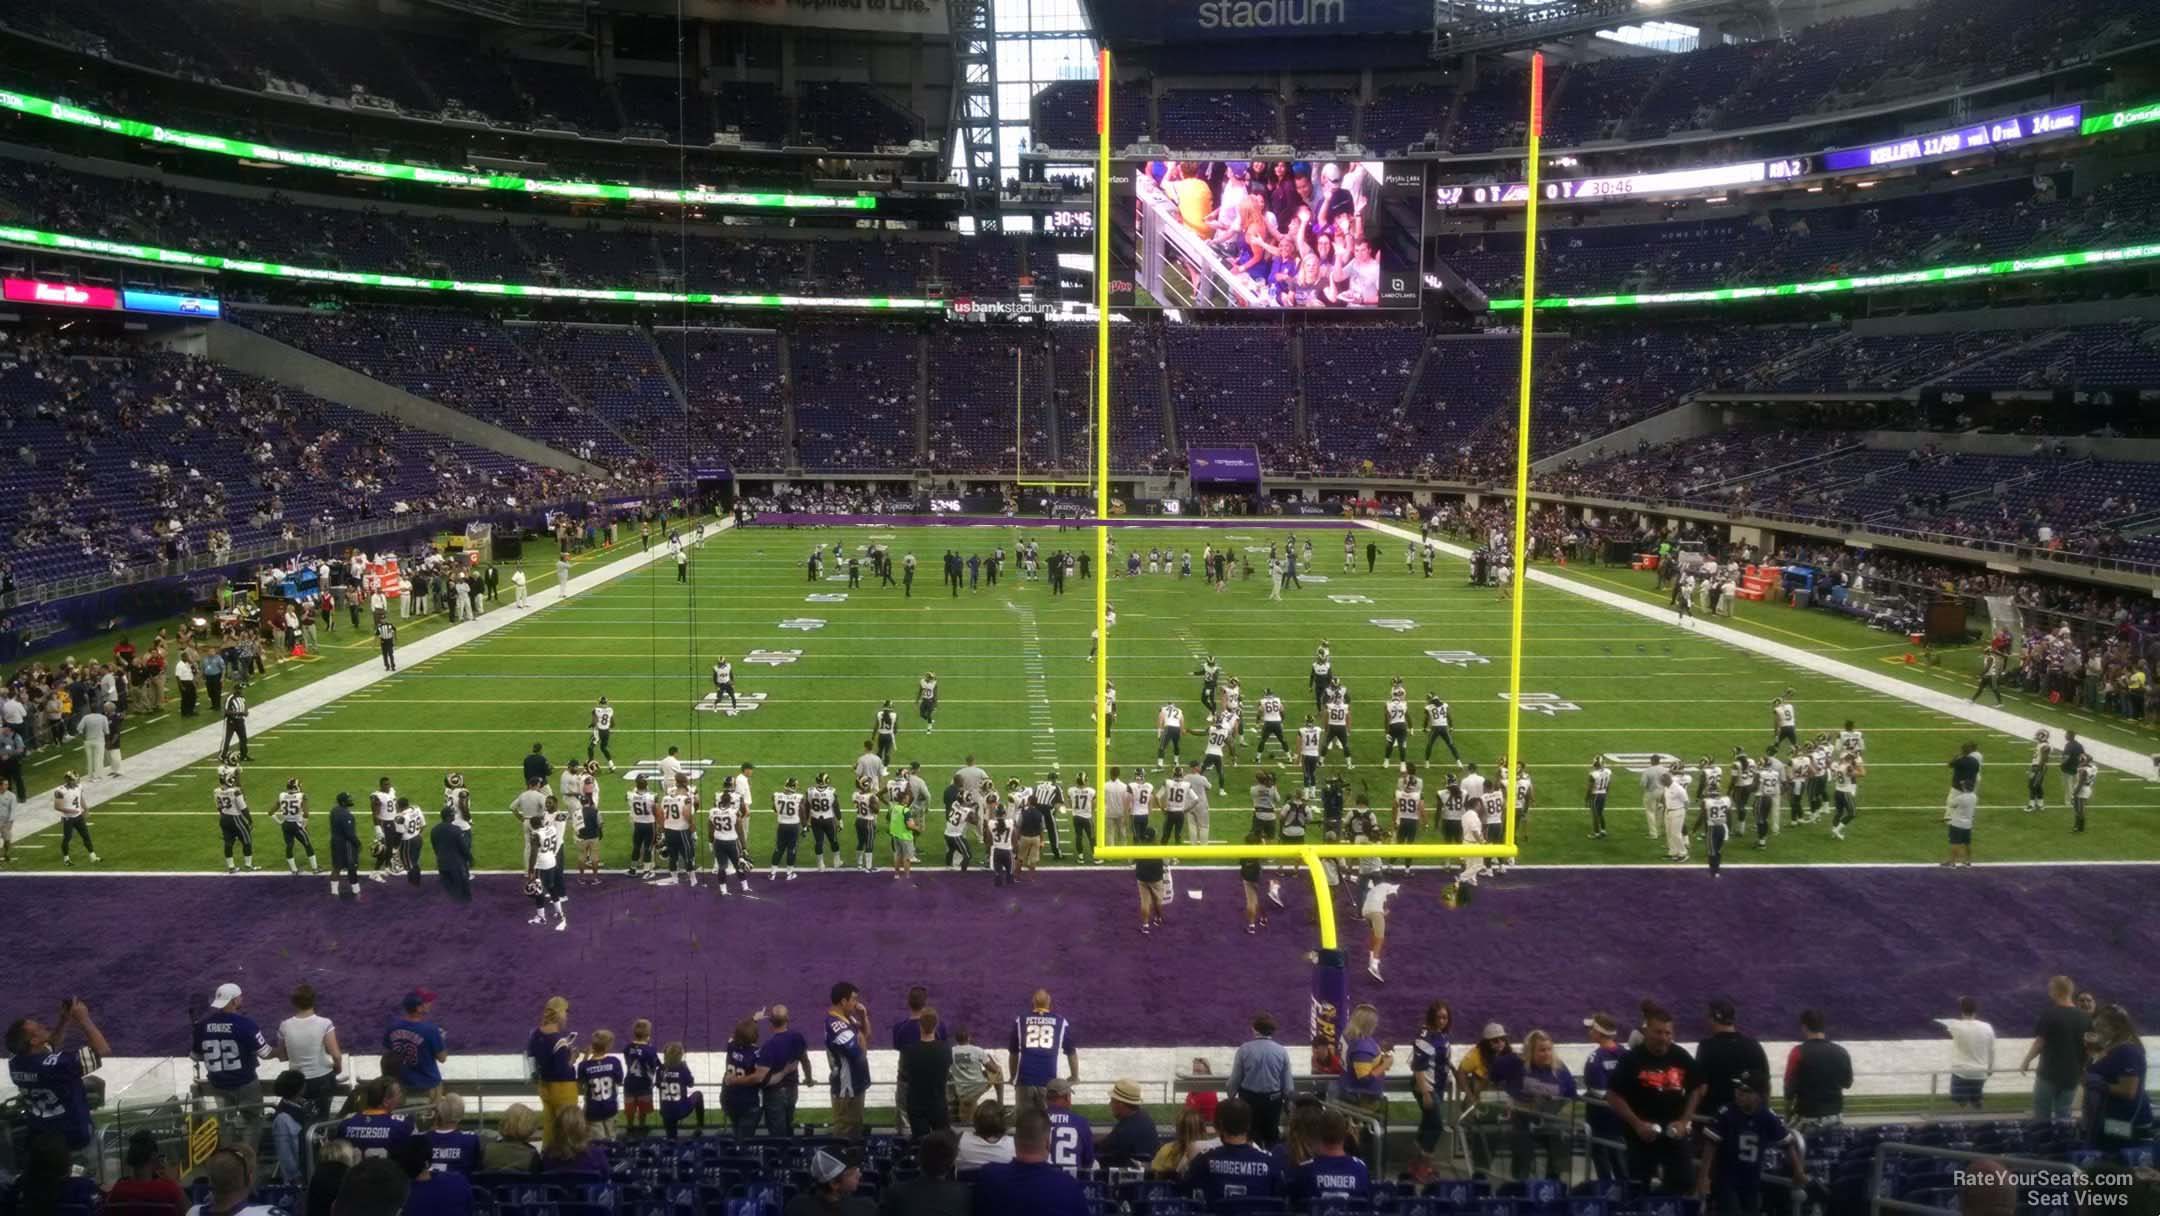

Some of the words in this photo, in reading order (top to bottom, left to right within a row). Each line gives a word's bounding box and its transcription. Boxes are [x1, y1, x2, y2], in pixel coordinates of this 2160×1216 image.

[1199, 0, 1345, 28] stadium
[1592, 182, 1633, 195] 30:46
[1054, 211, 1092, 226] 30:46
[1265, 701, 1279, 713] 66
[1330, 708, 1345, 721] 60
[1431, 707, 1445, 720] 84
[601, 714, 608, 726] 8
[1209, 733, 1225, 746] 30
[1304, 732, 1318, 746] 14
[71, 796, 79, 808] 4
[1139, 790, 1148, 804] 6
[1168, 788, 1184, 802] 16
[280, 800, 300, 816] 35
[632, 801, 650, 816] 61
[777, 801, 795, 816] 76
[811, 798, 830, 812] 68
[1073, 795, 1088, 811] 17
[1400, 798, 1417, 814] 89
[1445, 797, 1463, 811] 48
[1487, 799, 1503, 814] 88
[663, 804, 680, 820] 79
[1710, 806, 1728, 818] 83
[407, 816, 421, 834] 99
[713, 816, 732, 831] 63
[543, 835, 557, 853] 95
[206, 1023, 233, 1033] KRAUSE
[1025, 1016, 1057, 1026] PETERSON
[1025, 1025, 1054, 1048] 28
[201, 1039, 242, 1072] 22
[630, 1059, 642, 1077] 4
[588, 1077, 613, 1100] 28
[660, 1083, 681, 1101] 29
[345, 1126, 391, 1139] PETERSON
[1738, 1134, 1759, 1163] 5
[1209, 1159, 1269, 1177] BRIDGEWATER
[1316, 1175, 1356, 1189] PONDER
